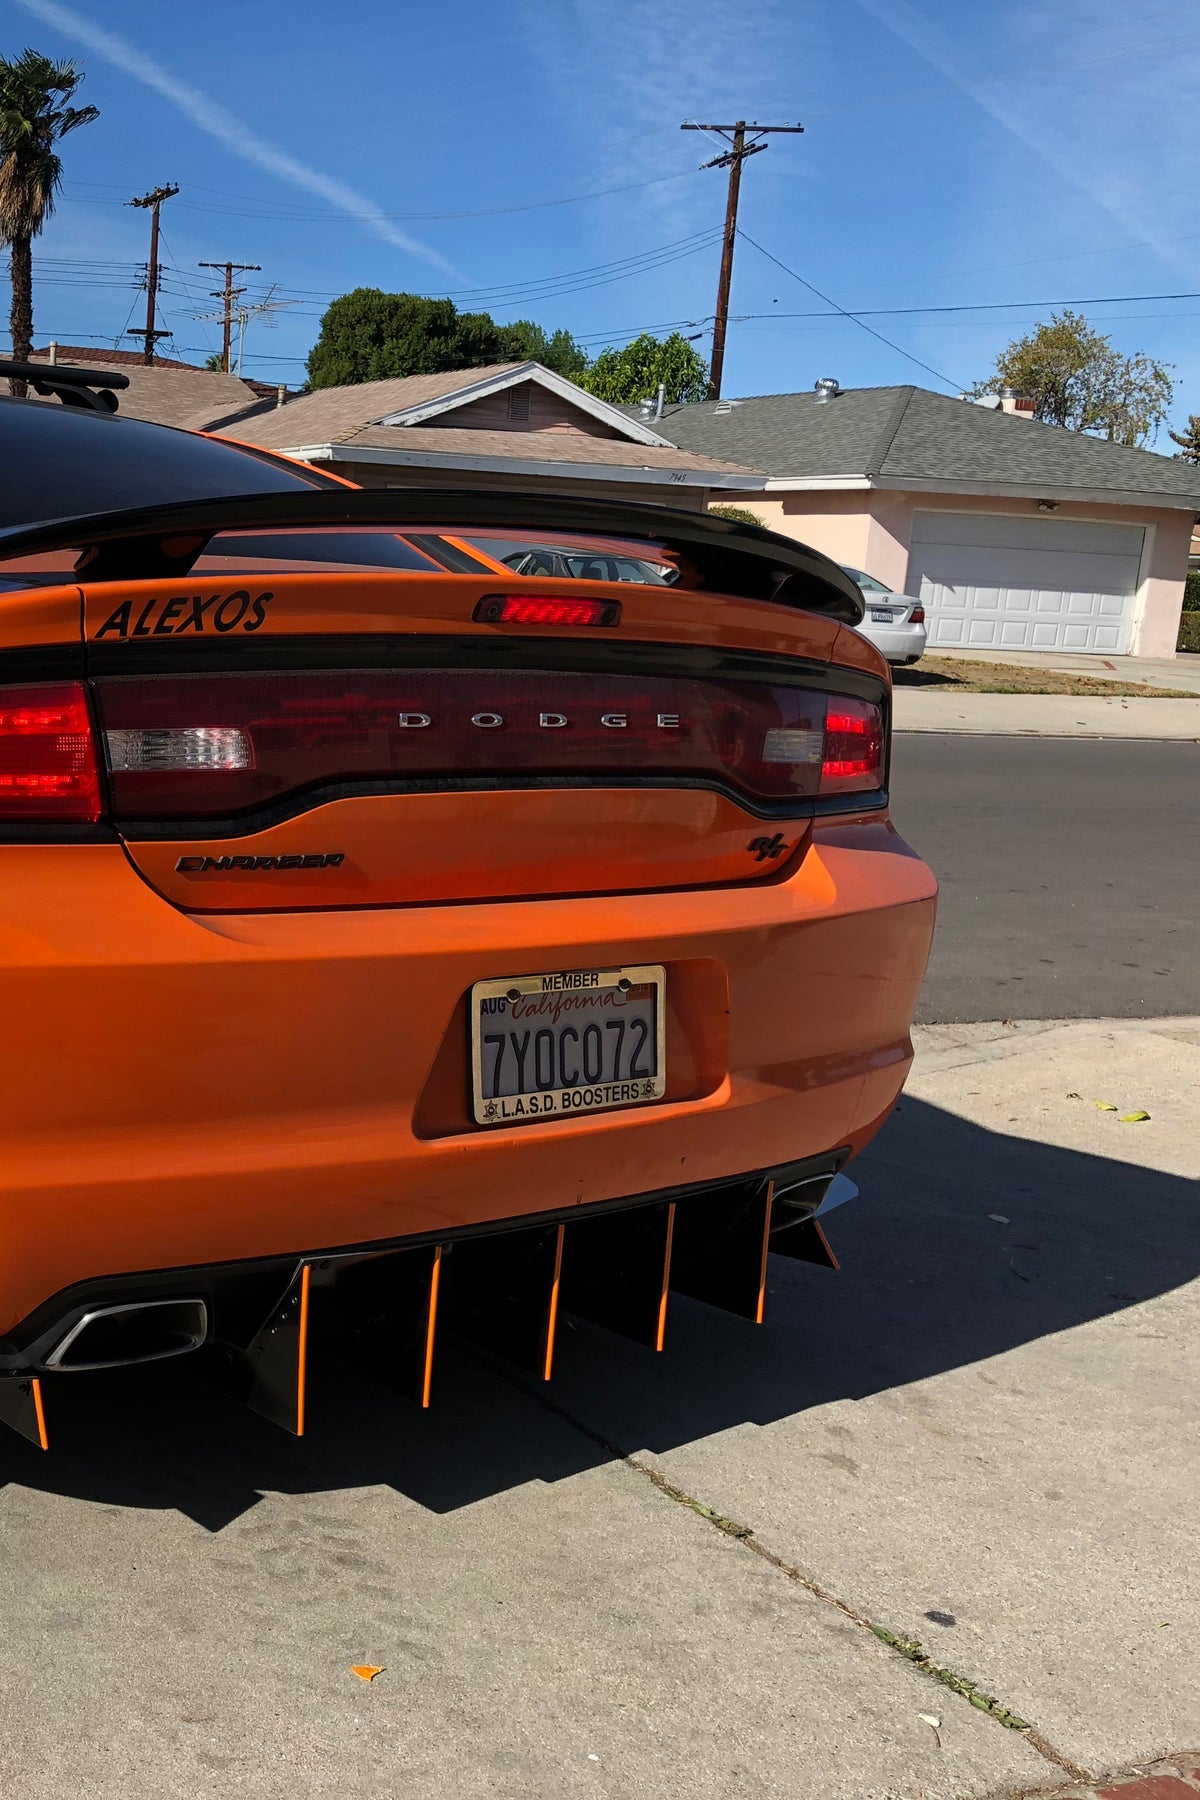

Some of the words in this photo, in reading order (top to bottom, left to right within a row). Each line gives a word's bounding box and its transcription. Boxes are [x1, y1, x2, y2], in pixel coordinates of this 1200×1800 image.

[94, 589, 275, 639] ALEXOS
[399, 712, 680, 728] DODGE
[175, 853, 346, 873] CHARGER
[542, 973, 599, 991] MEMBER
[481, 999, 506, 1016] AUG
[511, 991, 628, 1025] California
[501, 1095, 557, 1118] L.A.S.D.
[561, 1083, 640, 1110] BOOSTERS
